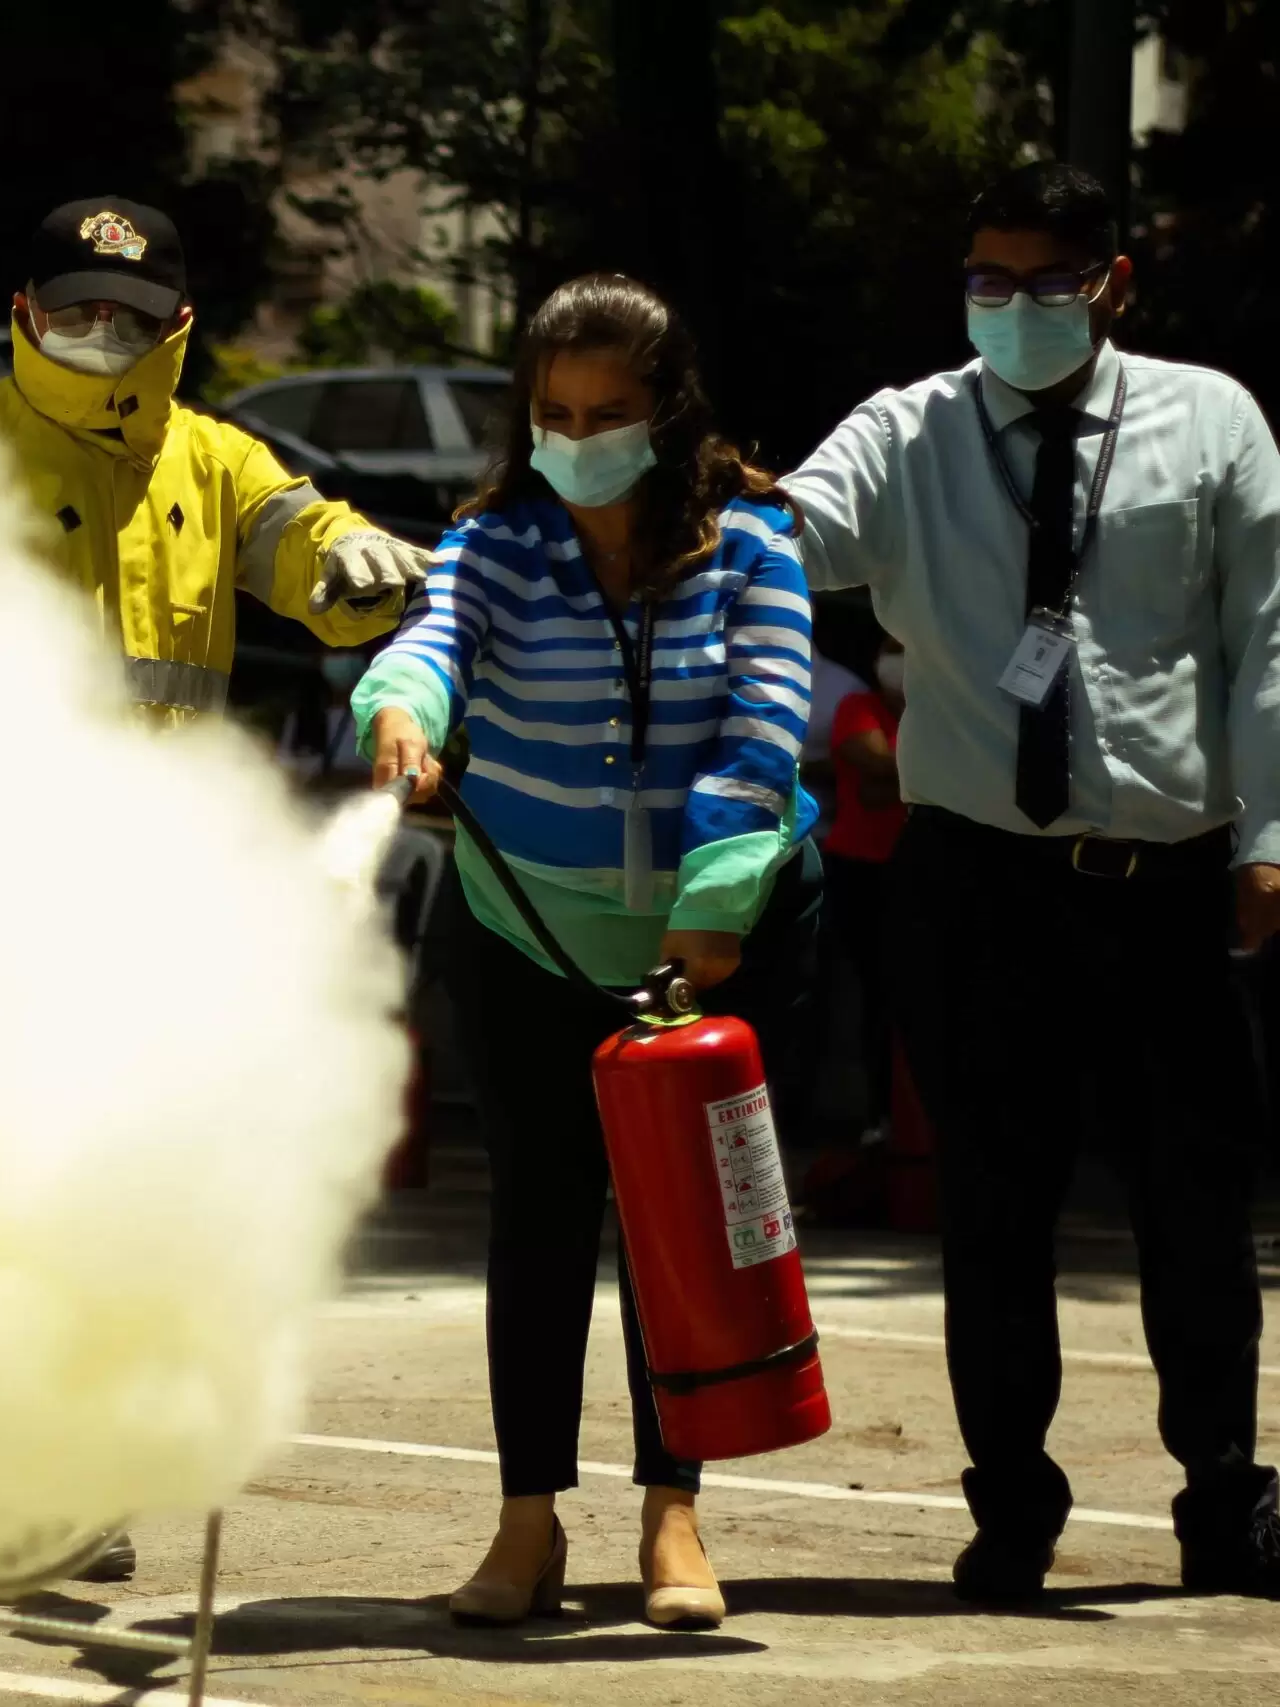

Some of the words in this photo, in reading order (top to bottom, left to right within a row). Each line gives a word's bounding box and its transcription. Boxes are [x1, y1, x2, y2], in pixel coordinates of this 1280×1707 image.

[720, 1158, 729, 1168] 2
[724, 1180, 733, 1189] 3
[728, 1201, 737, 1211] 4
